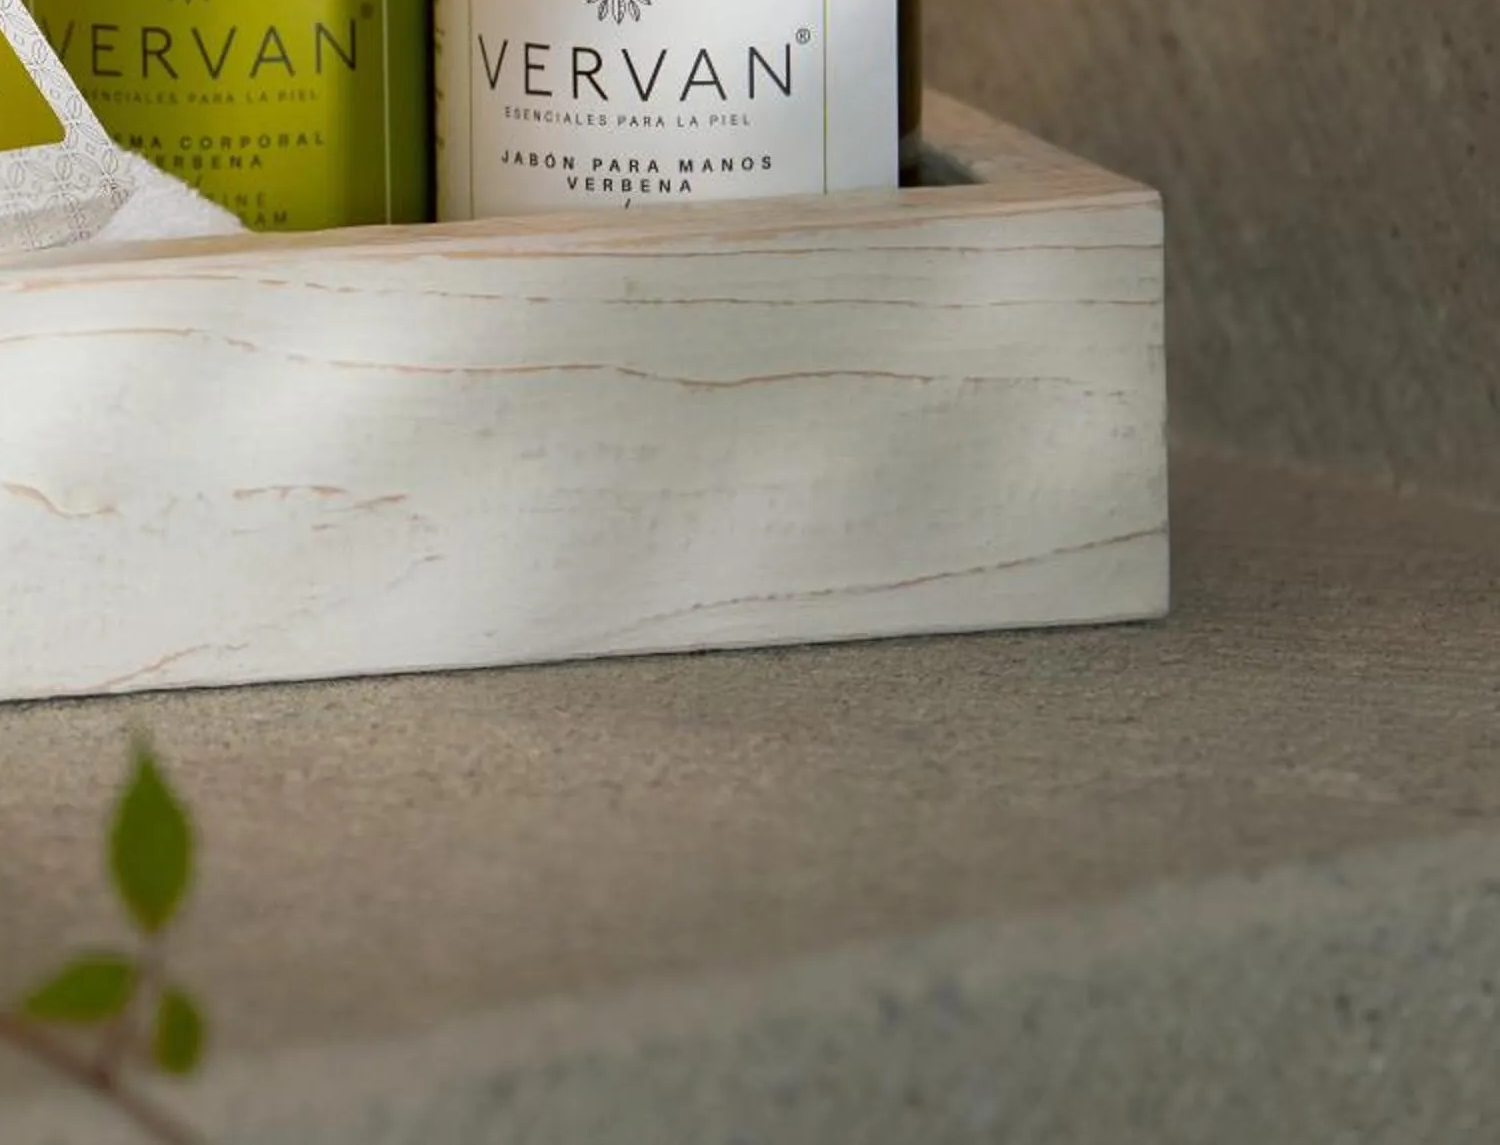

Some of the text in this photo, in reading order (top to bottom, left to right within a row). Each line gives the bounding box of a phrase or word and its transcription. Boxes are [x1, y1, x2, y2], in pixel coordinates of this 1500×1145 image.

[41, 16, 357, 81] VERVAN
[84, 86, 179, 105] ENCIALES
[504, 106, 751, 128] ESENCIALES PARA LA PIEL
[179, 130, 327, 151] CORPORAL
[144, 154, 263, 171] ERBENA
[501, 150, 773, 174] JABÓN PARA MANOS
[566, 176, 693, 194] VERBENA
